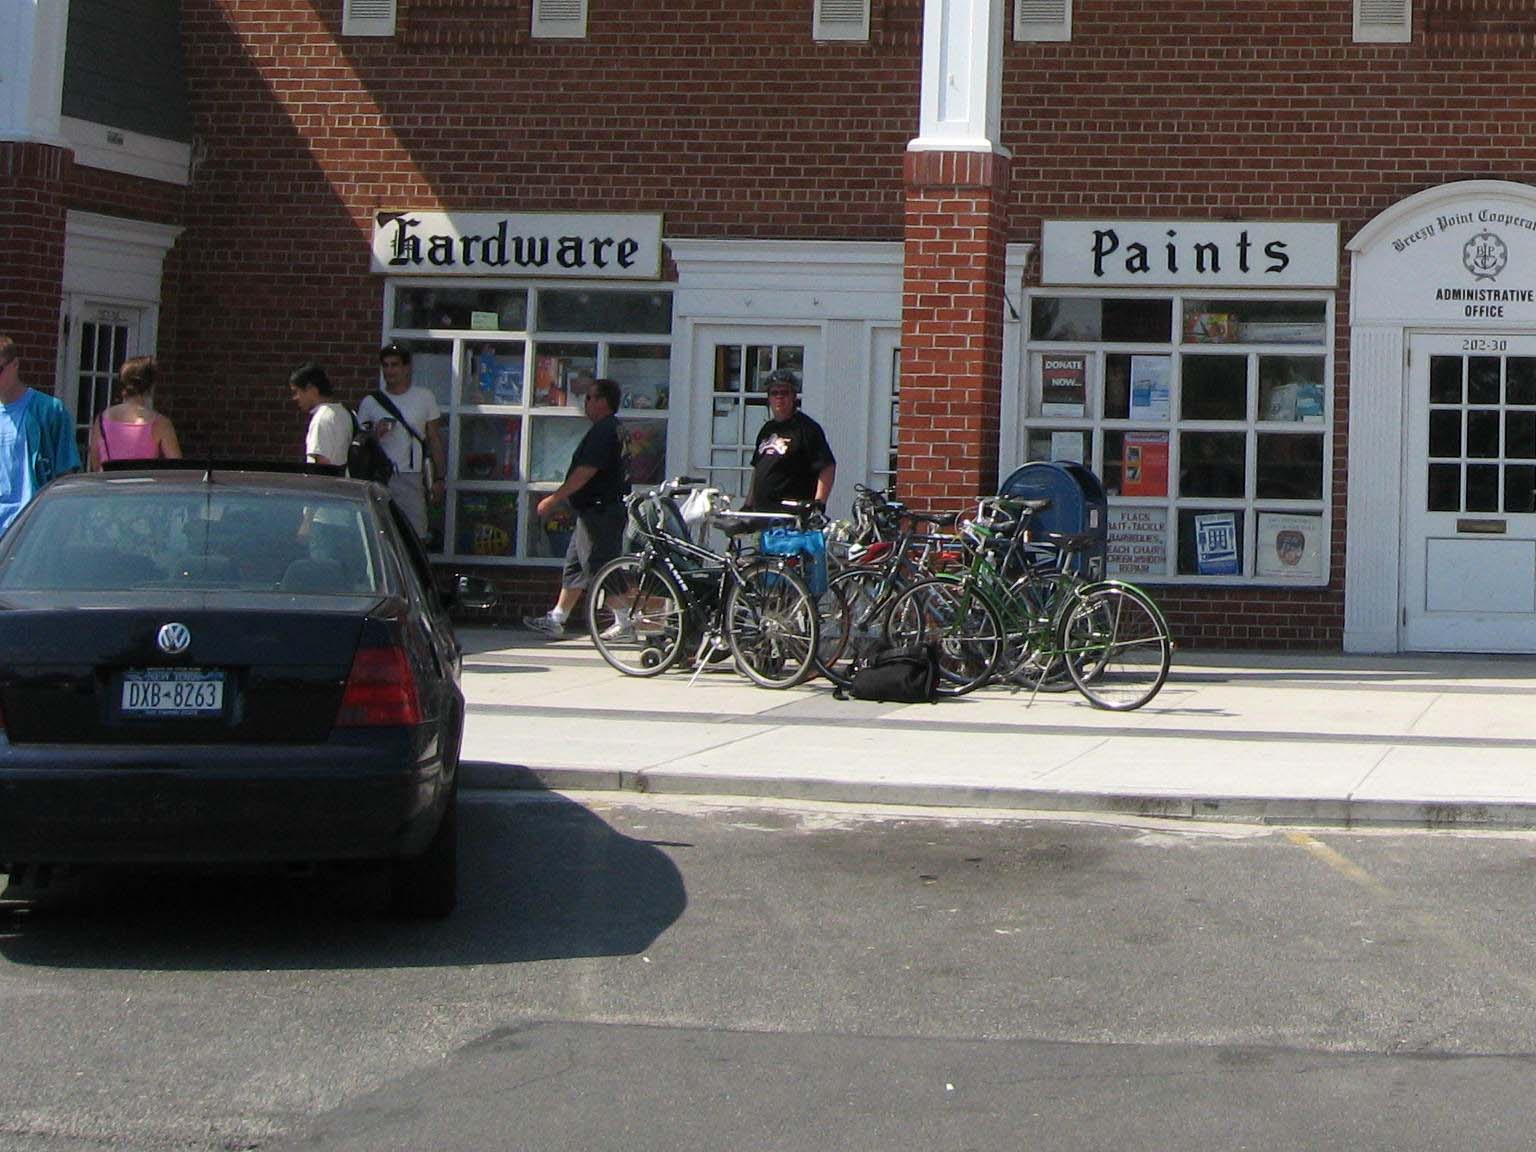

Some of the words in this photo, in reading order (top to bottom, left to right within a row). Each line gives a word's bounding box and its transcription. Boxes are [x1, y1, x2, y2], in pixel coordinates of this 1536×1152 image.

[1392, 224, 1436, 254] Breezy
[1436, 212, 1474, 232] Point
[1091, 228, 1290, 277] Paints
[1436, 288, 1535, 302] ADMINISTRATIVE
[1464, 305, 1504, 318] OFFICE
[1462, 339, 1507, 351] 202-30
[1045, 360, 1083, 369] DONATE
